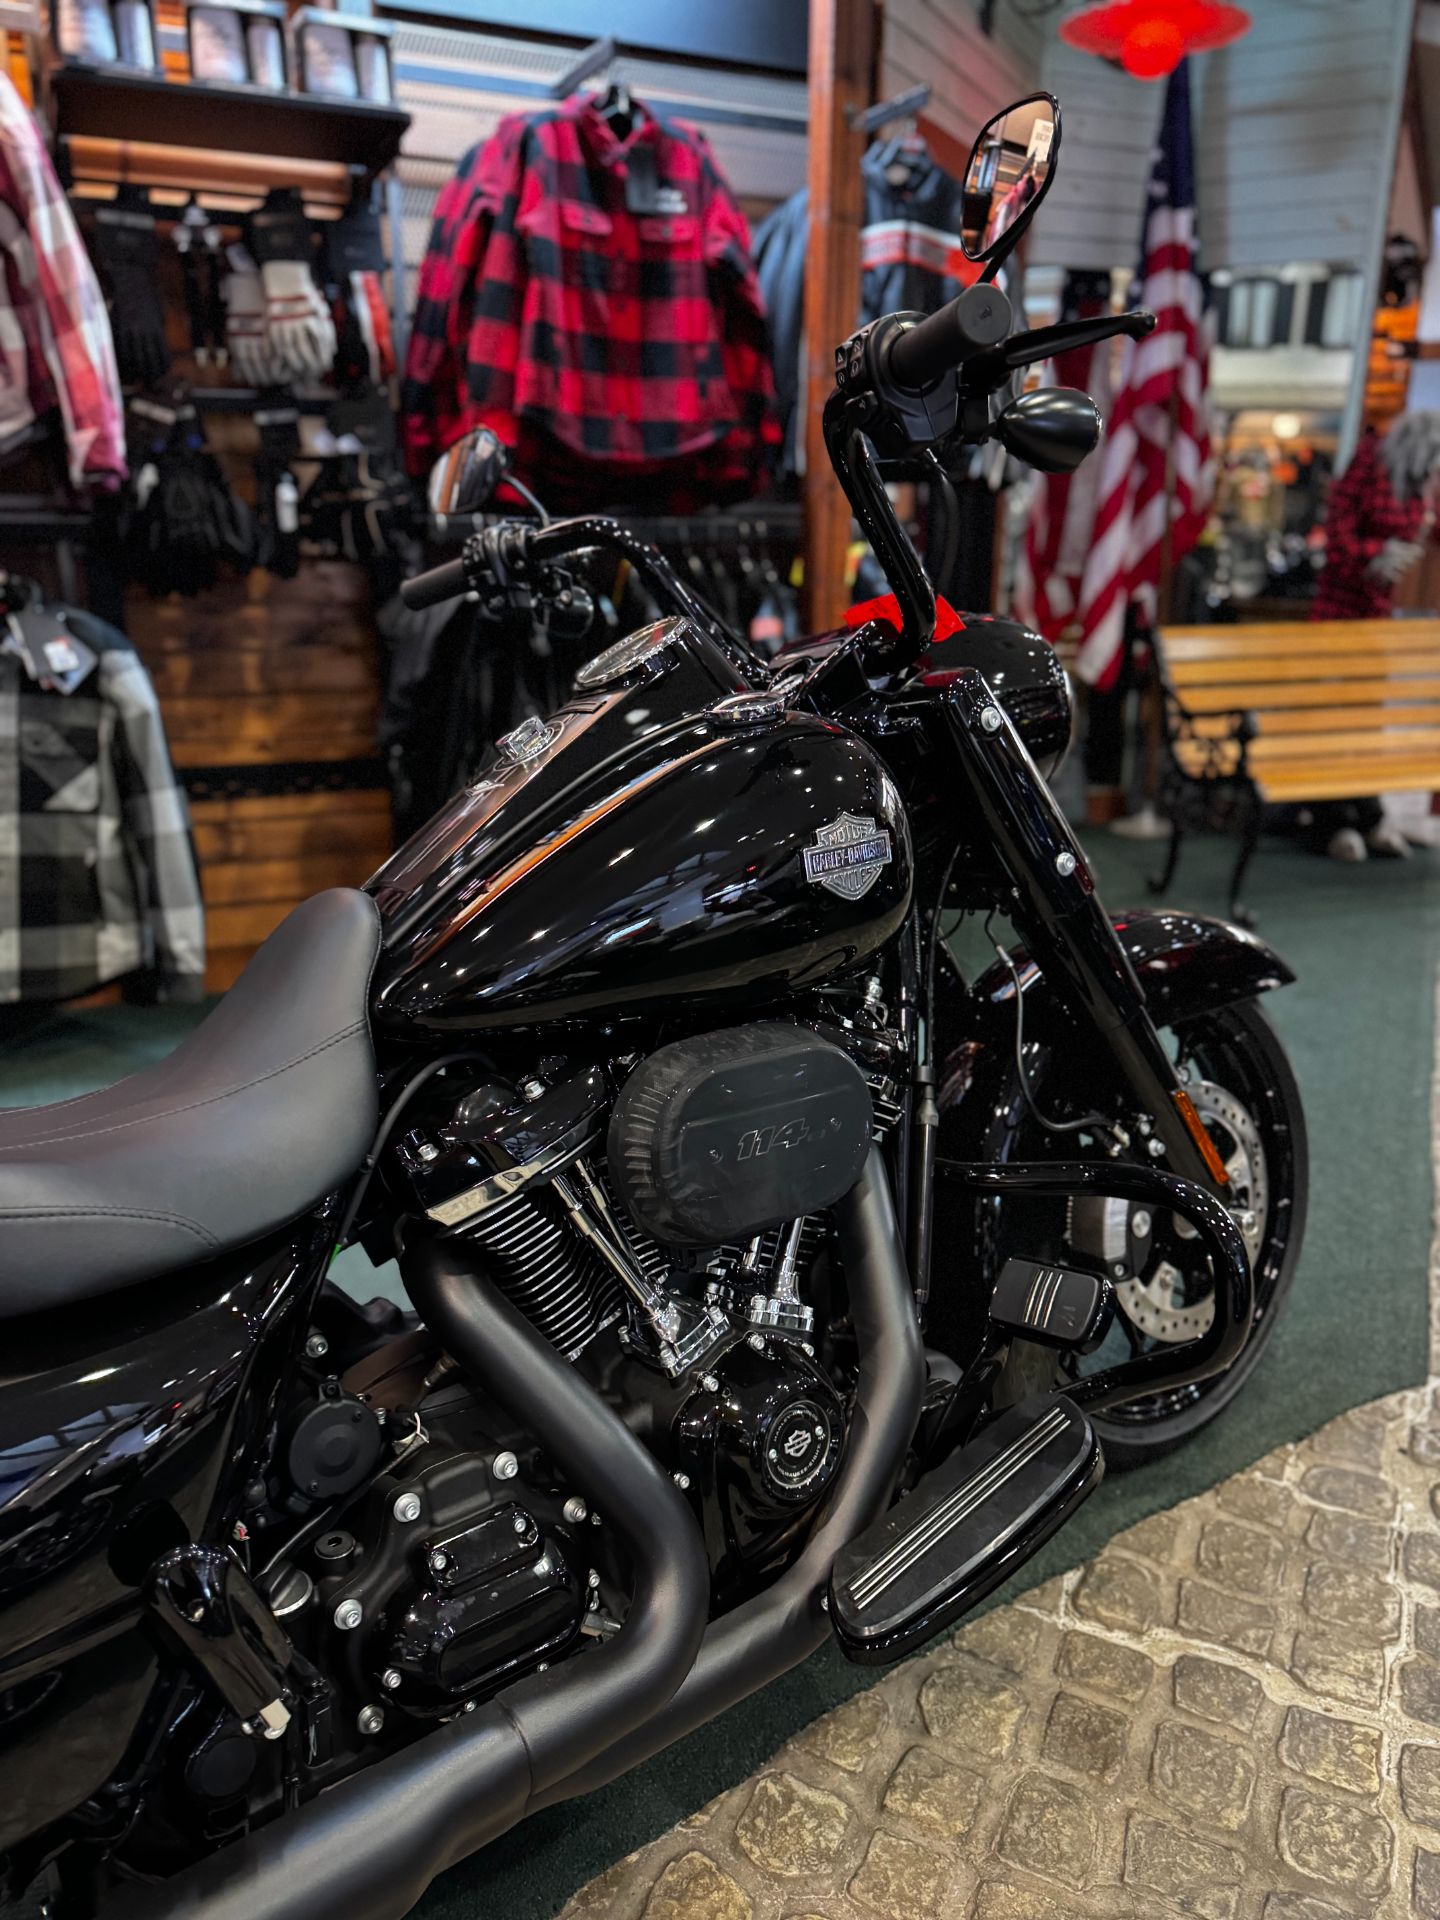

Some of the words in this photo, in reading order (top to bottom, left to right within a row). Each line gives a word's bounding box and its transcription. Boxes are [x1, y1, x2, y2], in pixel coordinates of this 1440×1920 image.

[828, 825, 868, 846] MOTOR
[812, 839, 886, 873] HARLEY-DAVIDSON
[737, 1117, 809, 1161] 114
